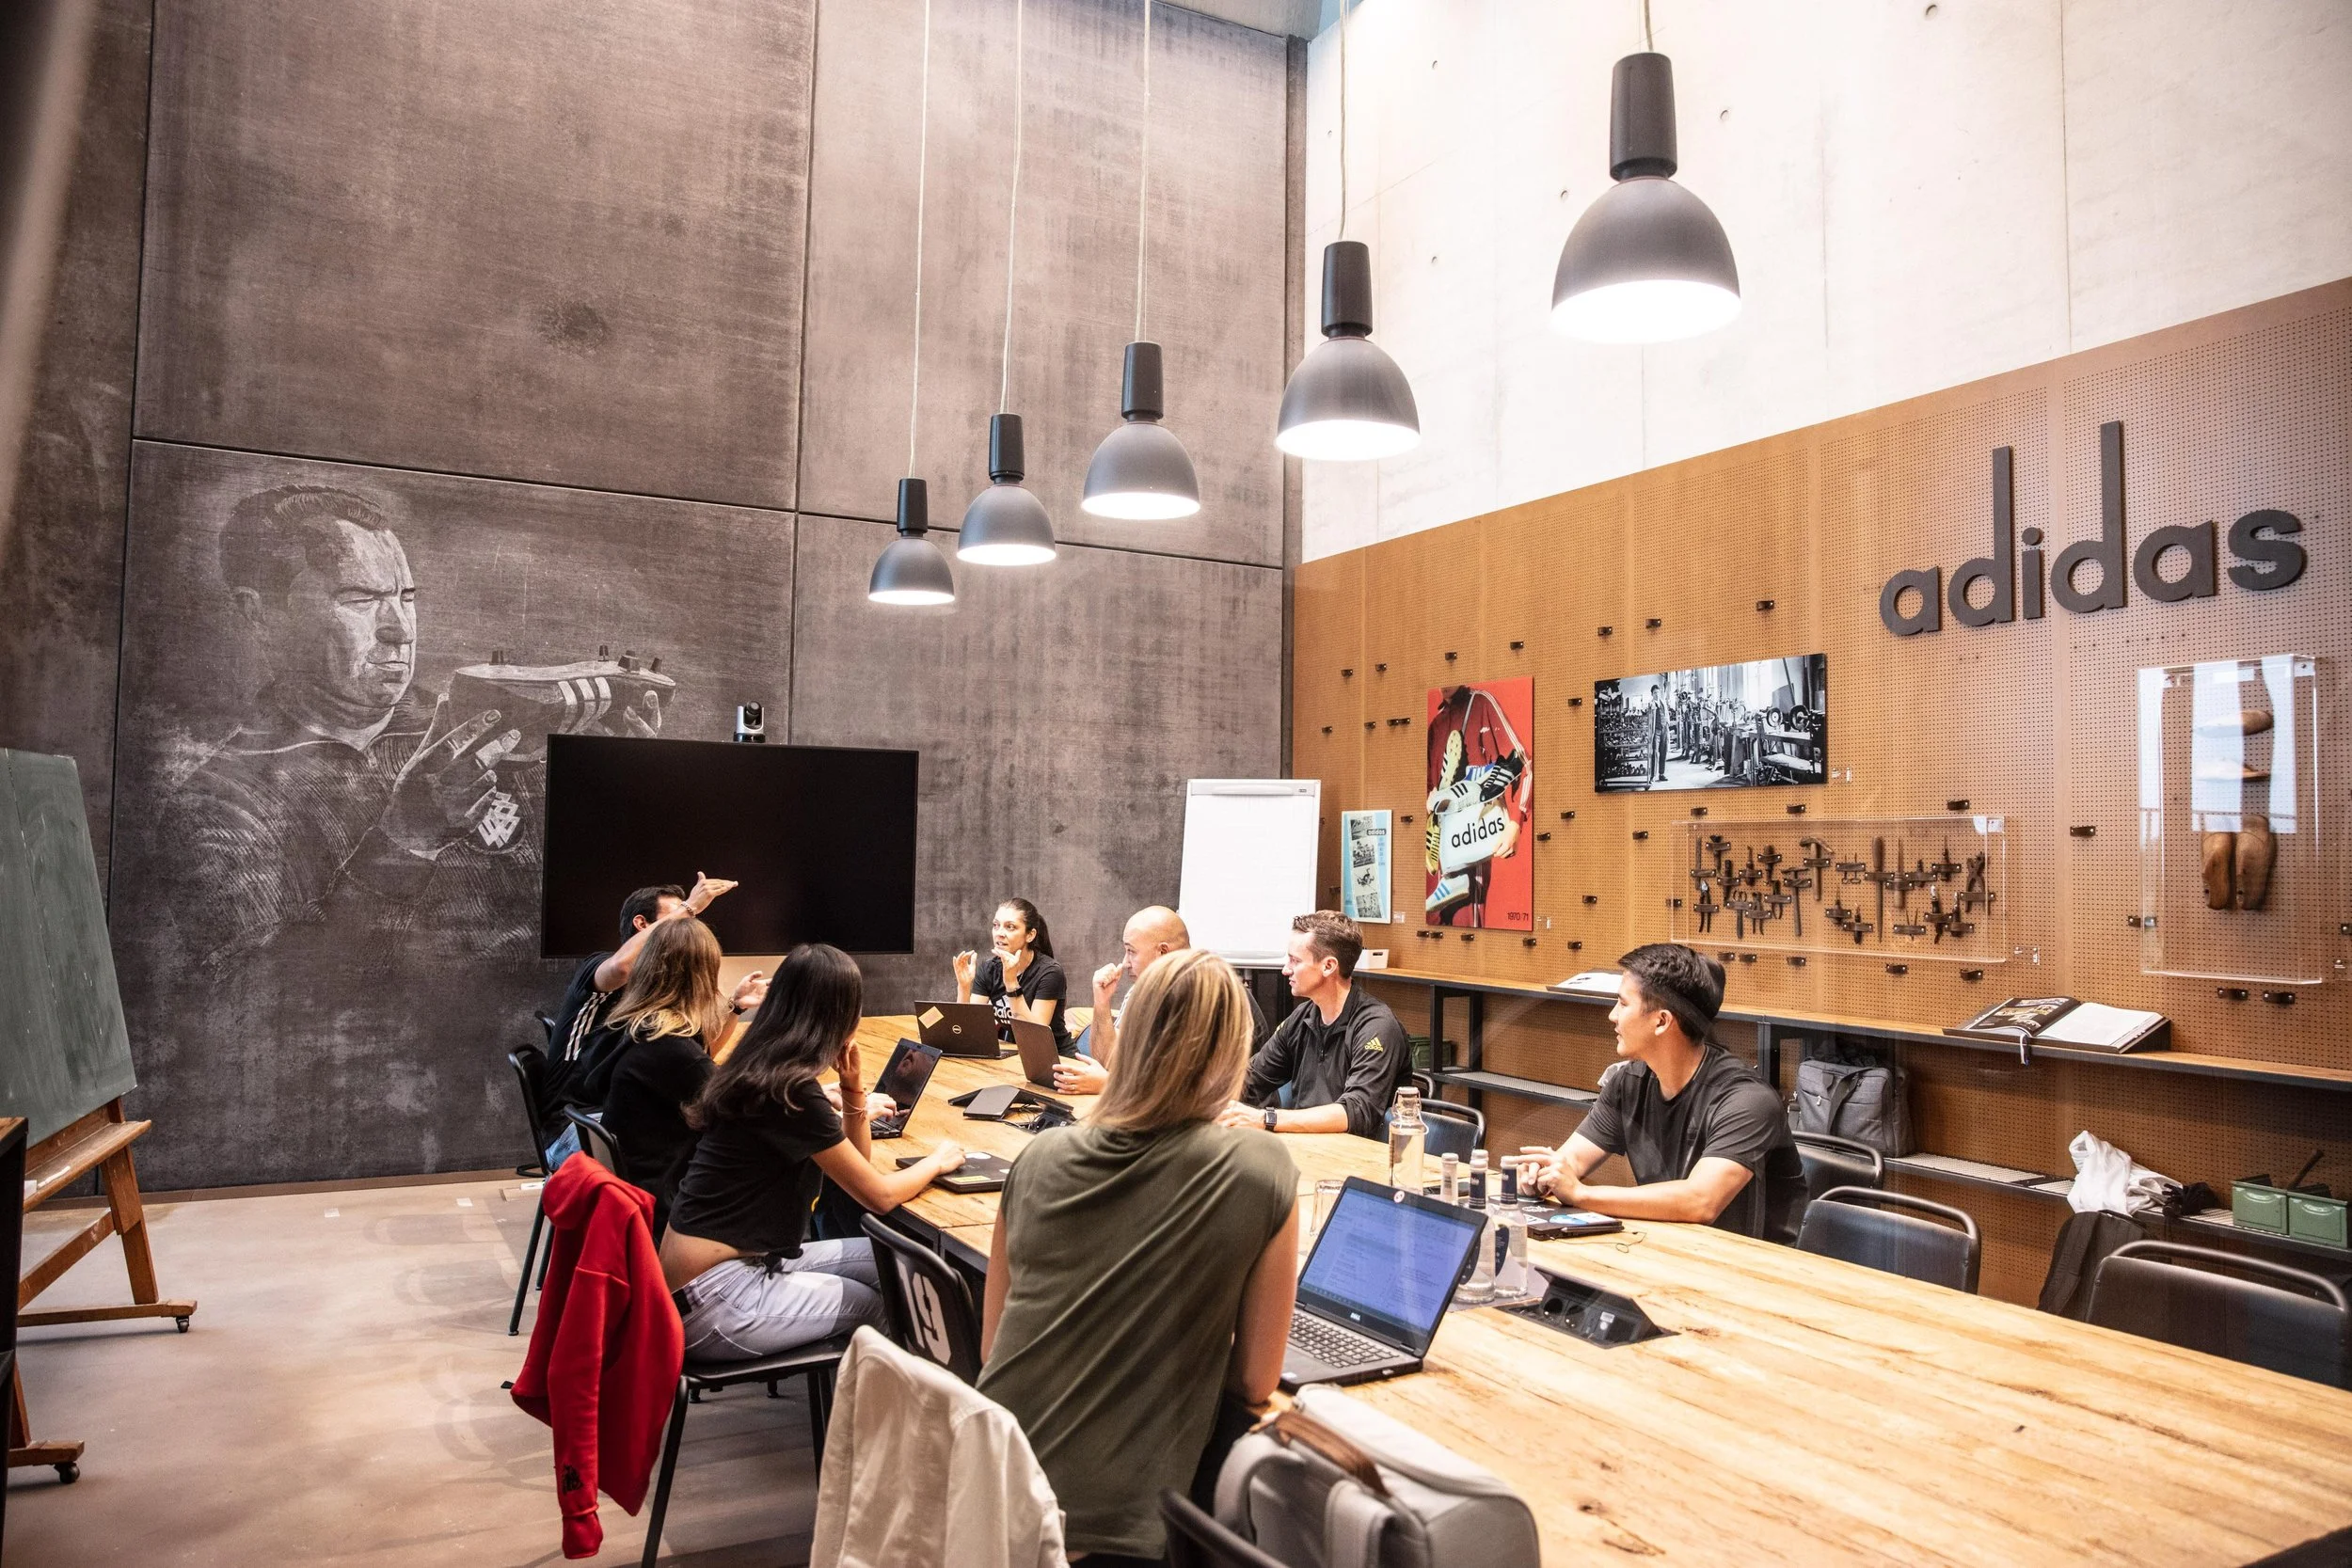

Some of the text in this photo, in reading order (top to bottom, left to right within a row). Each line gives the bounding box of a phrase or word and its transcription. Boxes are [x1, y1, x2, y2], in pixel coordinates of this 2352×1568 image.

[1880, 420, 2307, 636] adidas
[1452, 817, 1504, 847] adidas
[896, 1259, 951, 1365] 19
